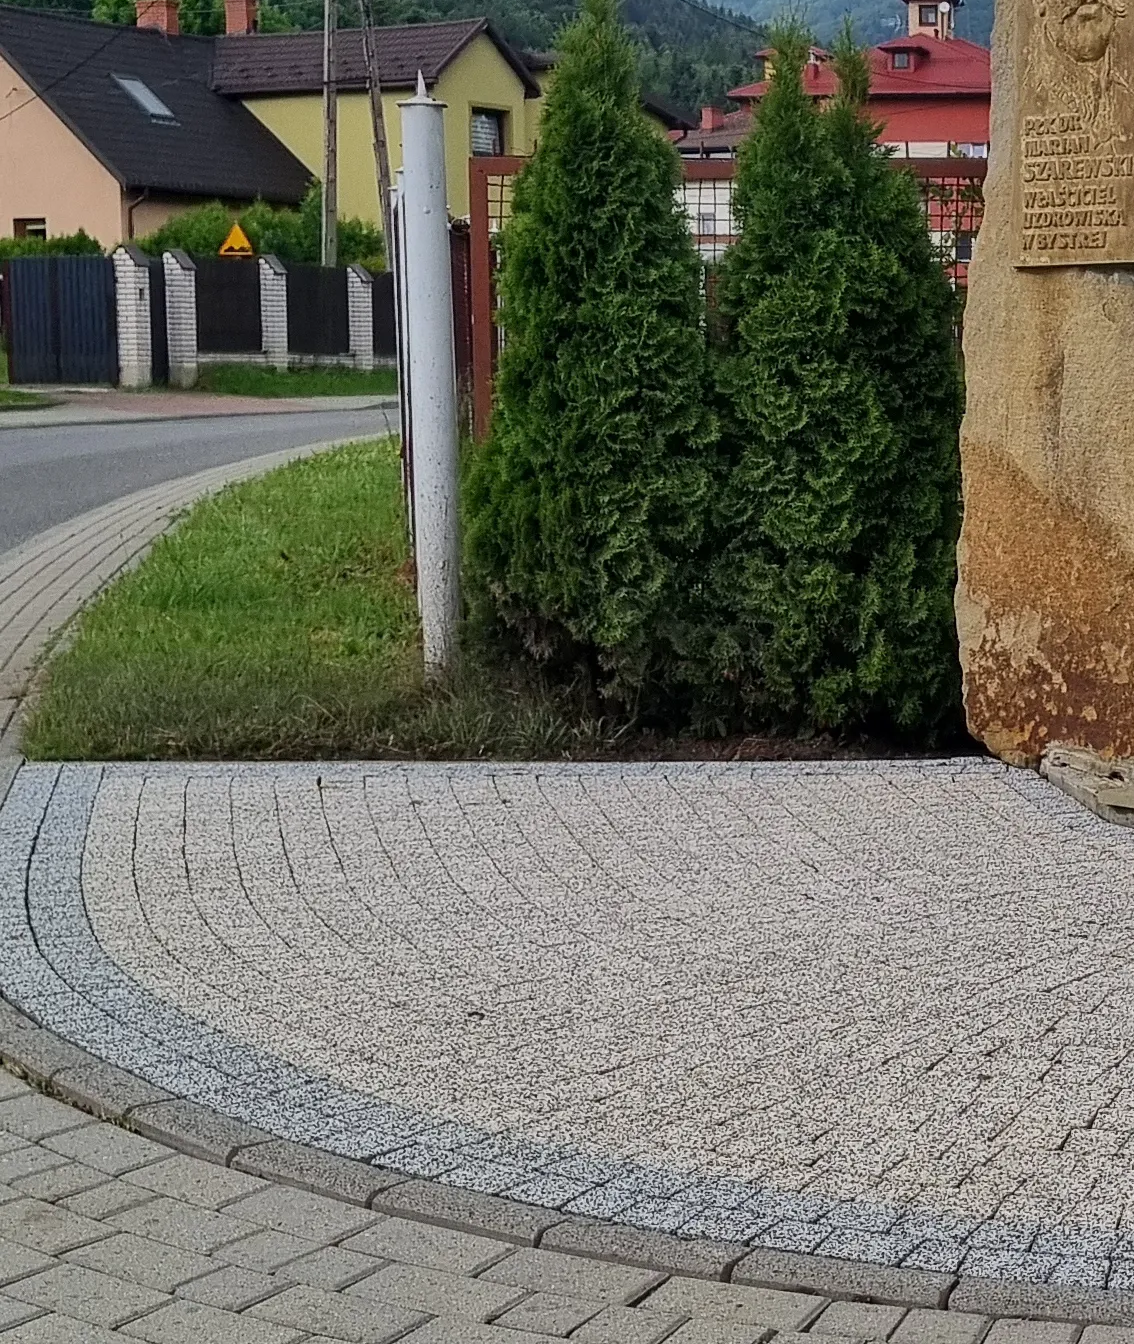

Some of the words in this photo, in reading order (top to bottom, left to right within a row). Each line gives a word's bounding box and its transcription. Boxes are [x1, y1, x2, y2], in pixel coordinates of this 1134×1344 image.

[1023, 135, 1091, 158] MARIAN
[1022, 153, 1134, 183] SZAREWSKI
[1022, 208, 1128, 230] UZDROWISKA
